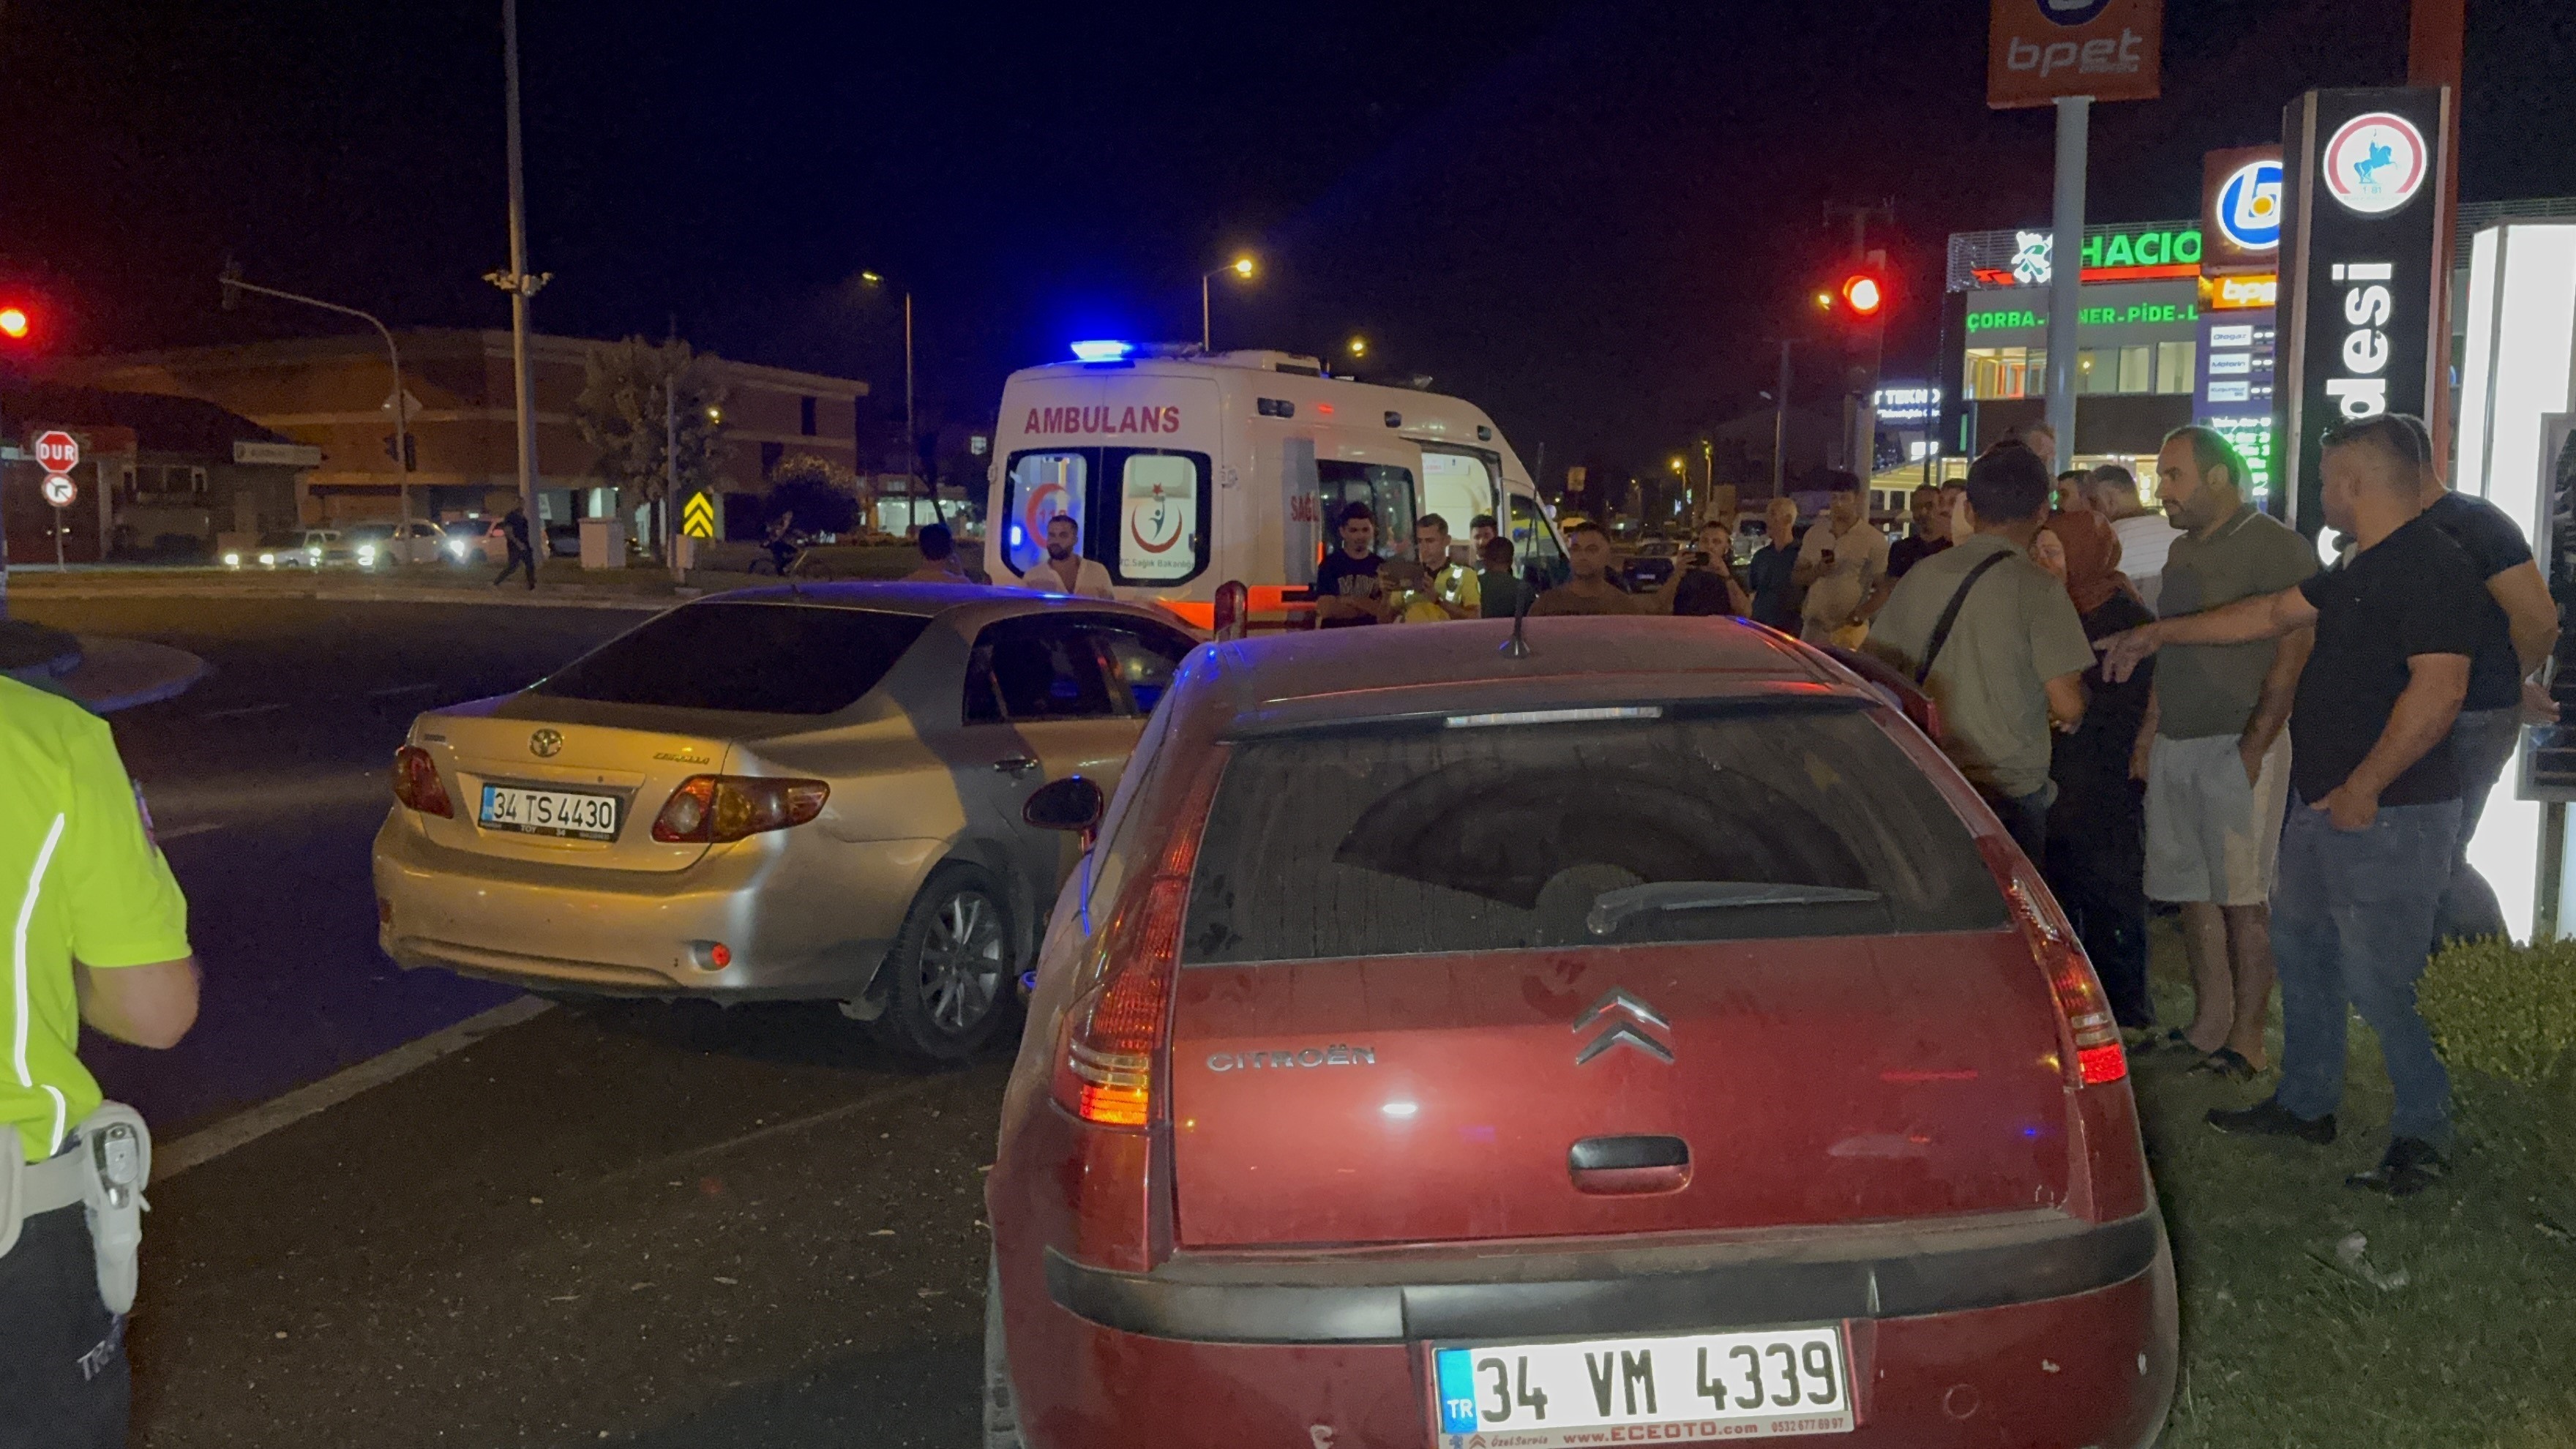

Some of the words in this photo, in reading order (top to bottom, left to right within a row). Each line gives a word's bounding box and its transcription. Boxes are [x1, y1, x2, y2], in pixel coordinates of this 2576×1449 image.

[2007, 28, 2143, 78] bpet
[2081, 231, 2201, 266] HACIO
[1025, 406, 1180, 433] AMBULANS
[40, 443, 74, 461] DUR
[494, 793, 517, 820] 34
[526, 795, 553, 823] TS
[558, 798, 612, 828] 4430
[1207, 1043, 1376, 1071] CITROËN
[1448, 1399, 1473, 1418] TR
[1477, 1355, 1548, 1423] 34
[1585, 1349, 1657, 1417] VM
[1697, 1341, 1838, 1411] 4339
[1563, 1421, 1758, 1443] www.ECEOTO.com
